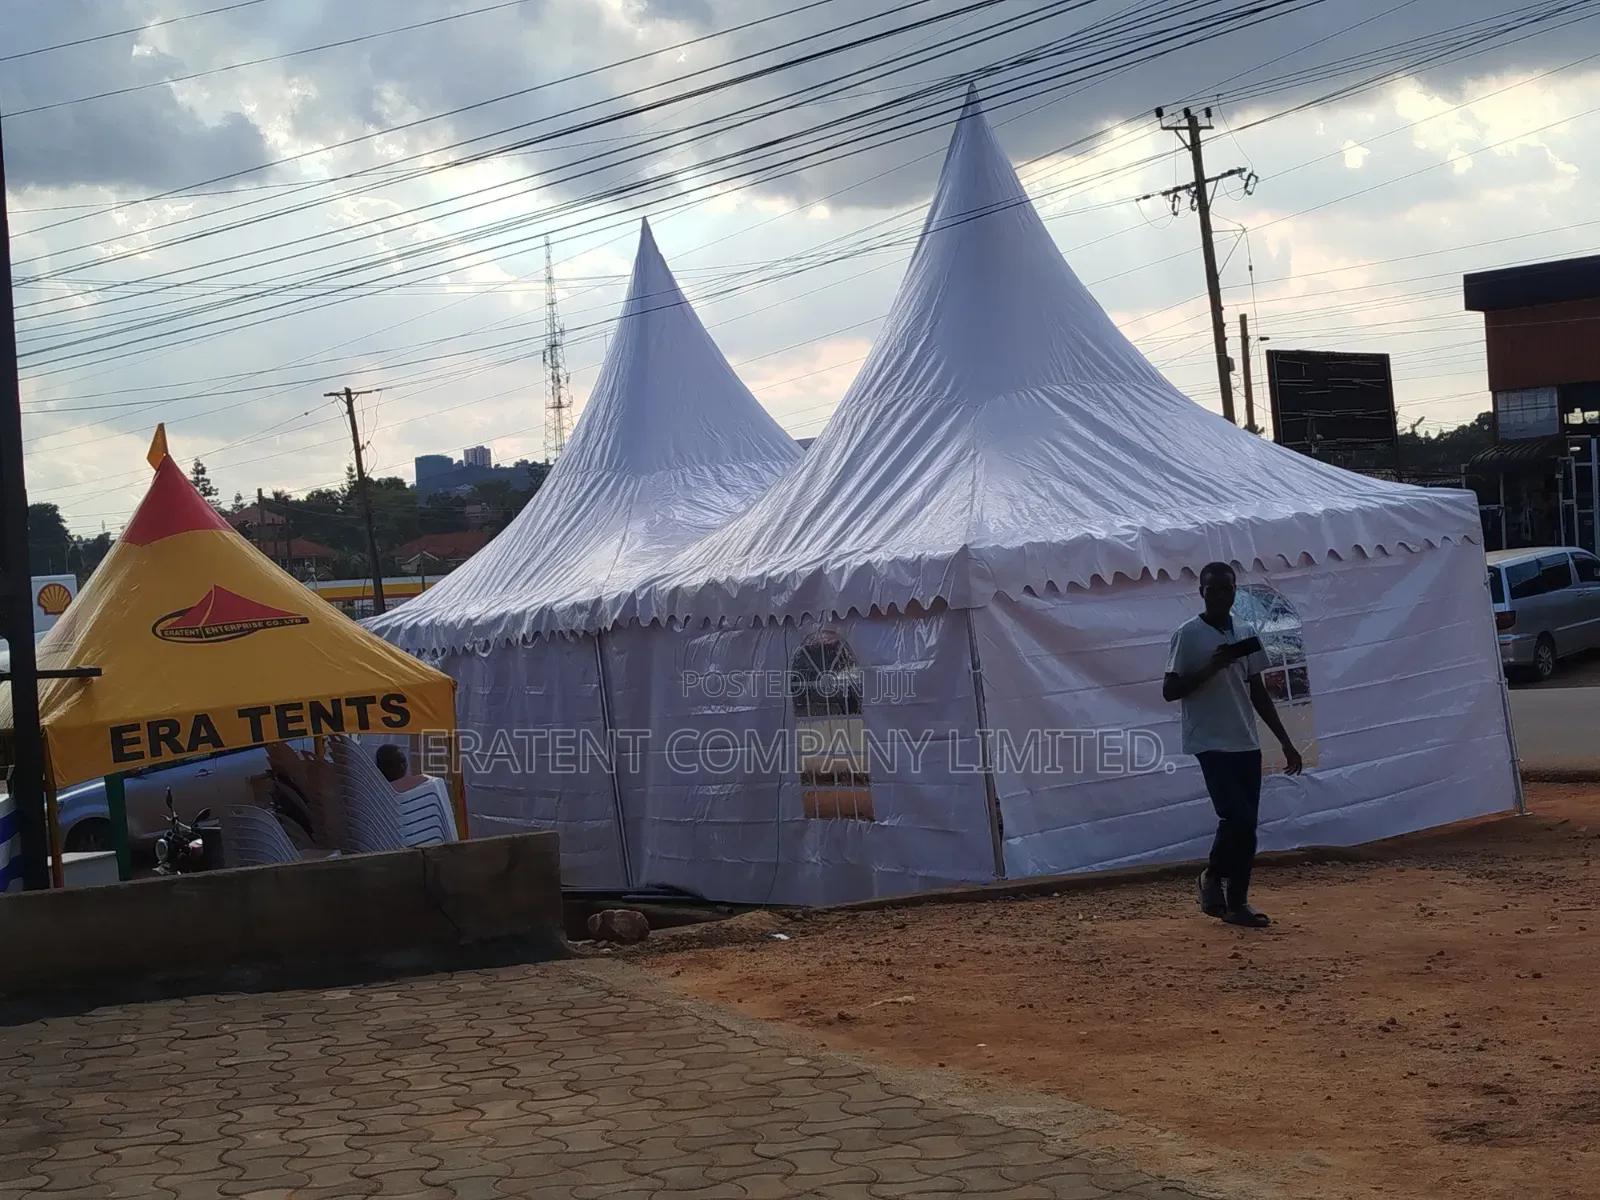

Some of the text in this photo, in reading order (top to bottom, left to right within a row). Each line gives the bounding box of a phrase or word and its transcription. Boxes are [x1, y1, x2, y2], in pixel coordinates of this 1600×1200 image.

[163, 627, 200, 638] ERATENT
[205, 621, 264, 635] ENTERPRISE
[109, 693, 411, 764] ERA TENTS
